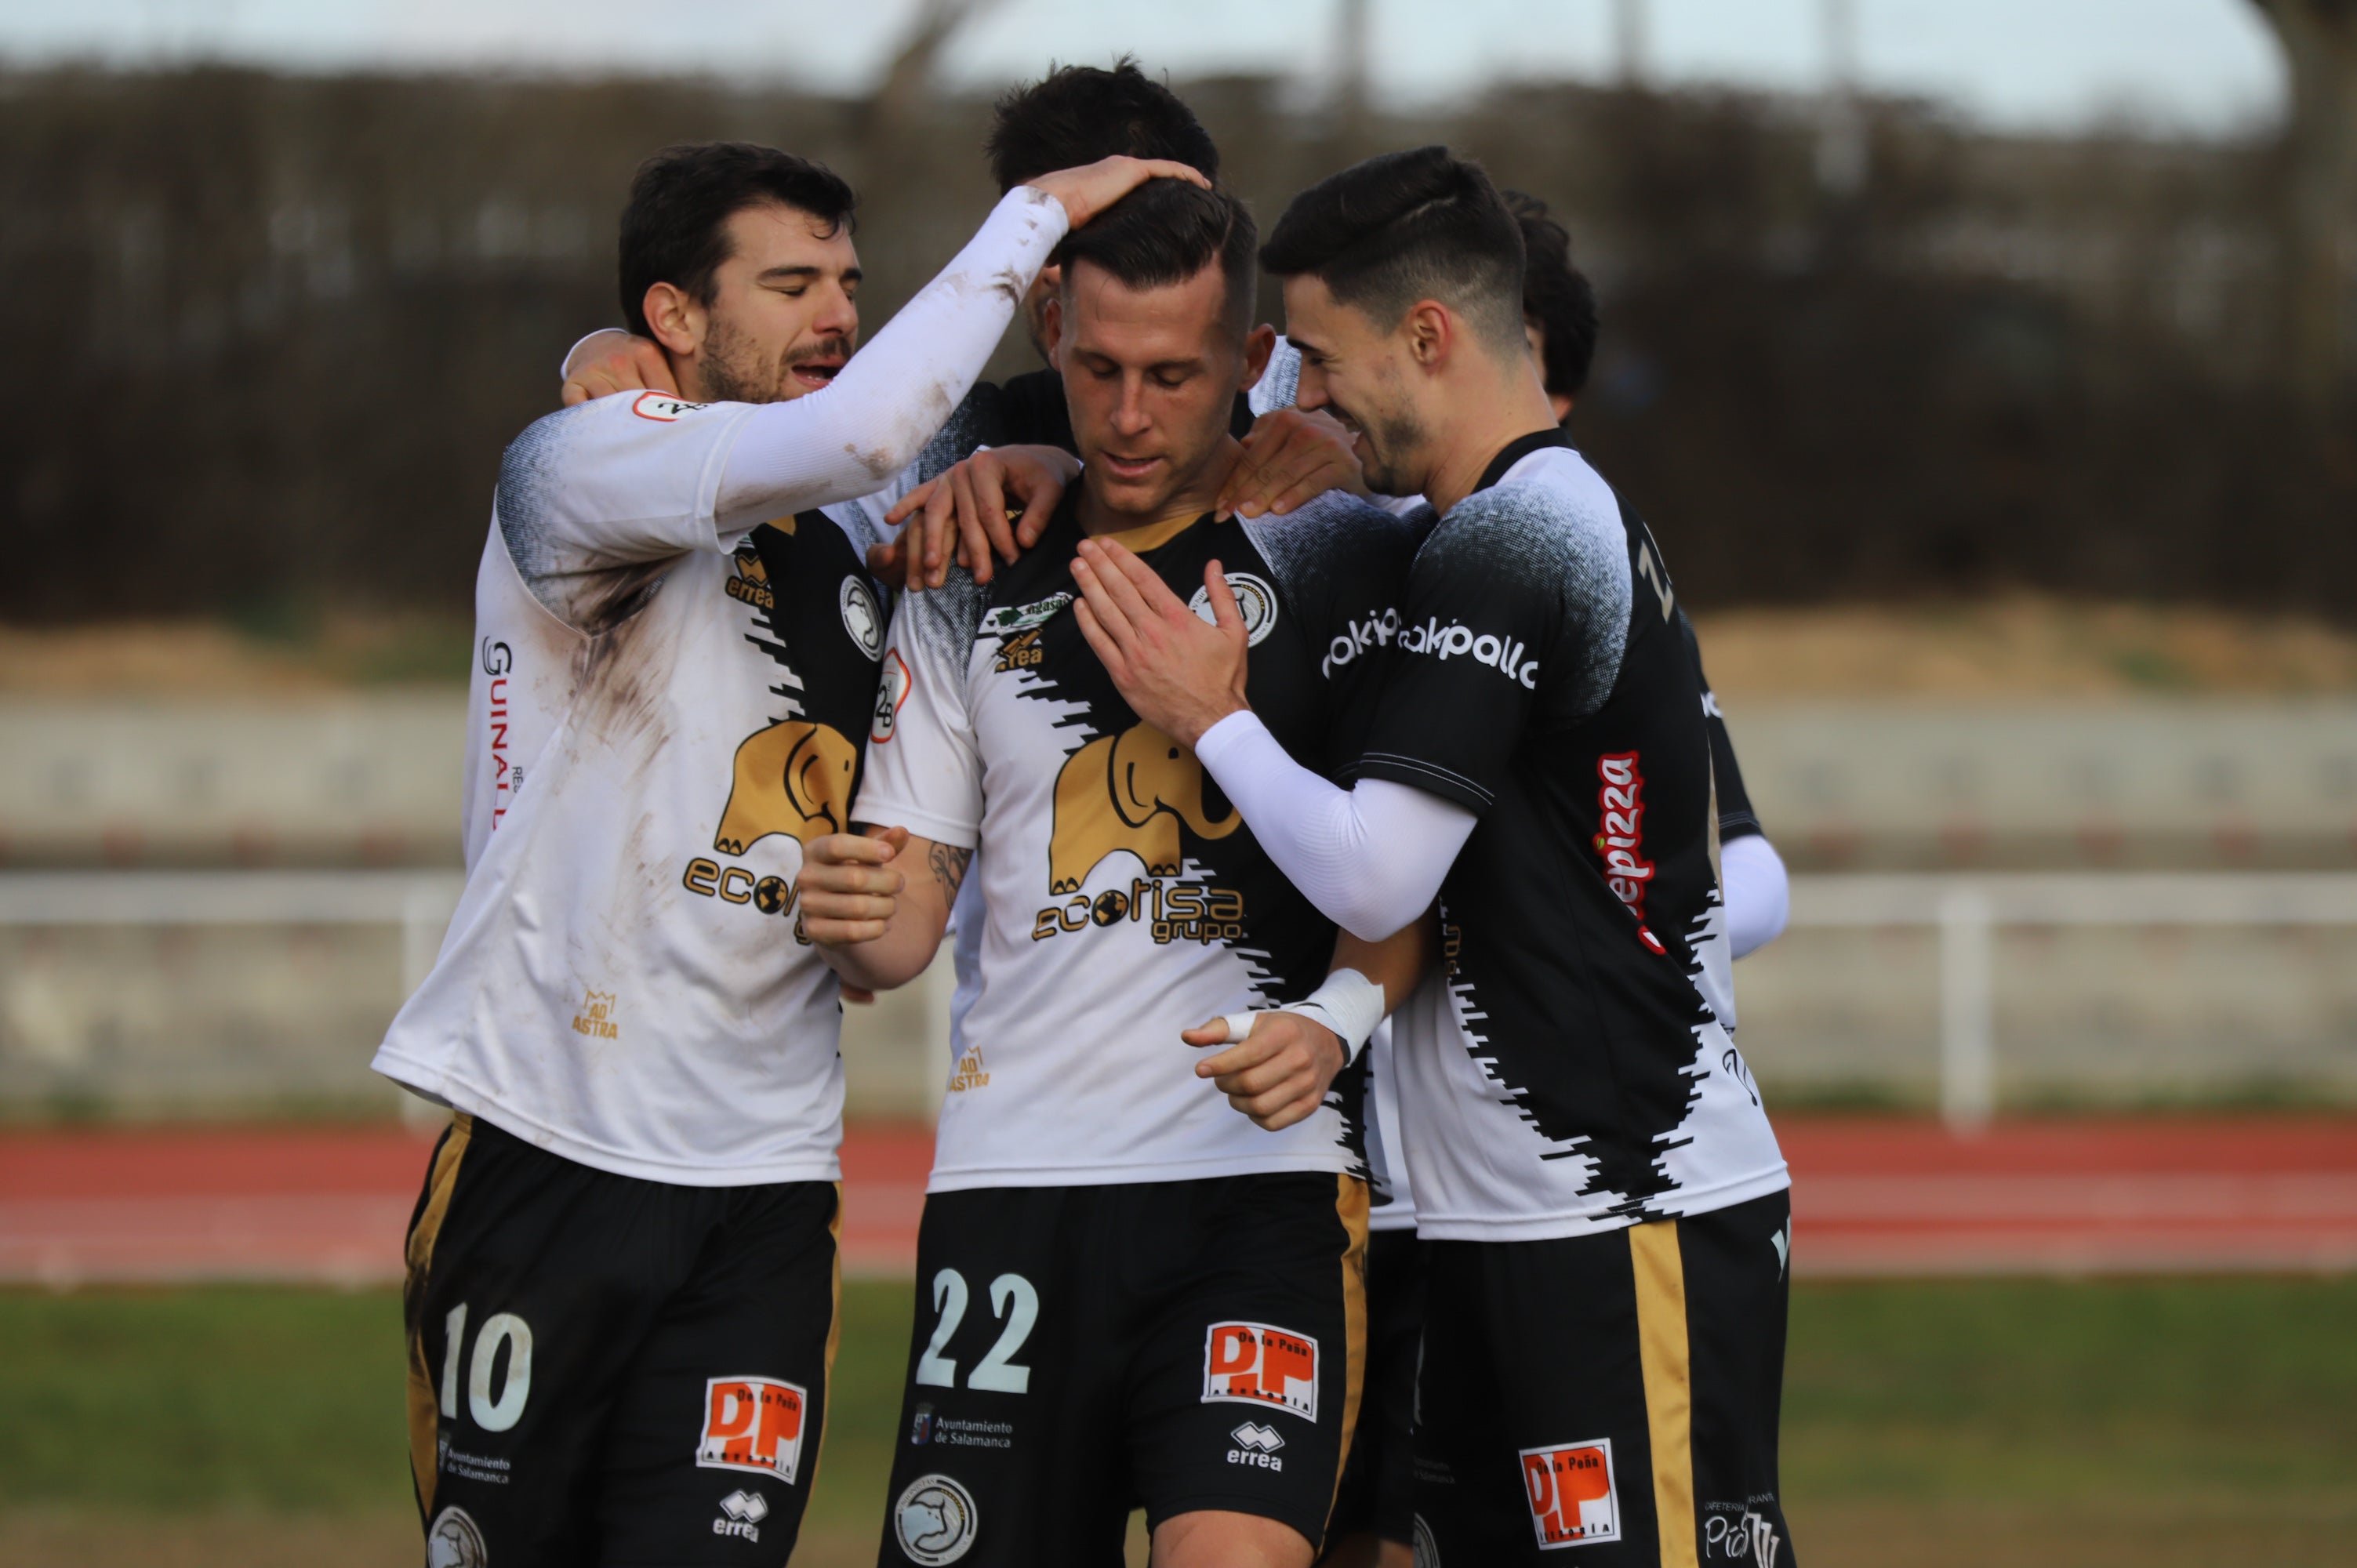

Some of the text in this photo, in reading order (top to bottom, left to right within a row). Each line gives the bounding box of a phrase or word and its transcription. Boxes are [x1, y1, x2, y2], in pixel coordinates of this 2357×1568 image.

[728, 578, 775, 609] errea
[1031, 878, 1244, 942] ecorisa
[1151, 920, 1243, 946] grupo
[589, 1004, 608, 1019] AD
[572, 1015, 618, 1040] ASTRA
[960, 1058, 978, 1073] AD
[949, 1073, 990, 1091] ASTRA
[916, 1269, 1039, 1394] 22
[1238, 1332, 1307, 1357] De la Peña
[441, 1302, 533, 1432] 10
[737, 1389, 754, 1402] De
[761, 1391, 771, 1403] la
[935, 1417, 1012, 1434] Ayuntamiento
[935, 1432, 1011, 1449] de Salamanca
[448, 1448, 510, 1471] Ayuntamiento
[1226, 1449, 1283, 1472] errea
[1553, 1460, 1563, 1473] la
[1569, 1454, 1599, 1471] Peña
[459, 1465, 509, 1485] Salamanca
[712, 1516, 760, 1544] errea
